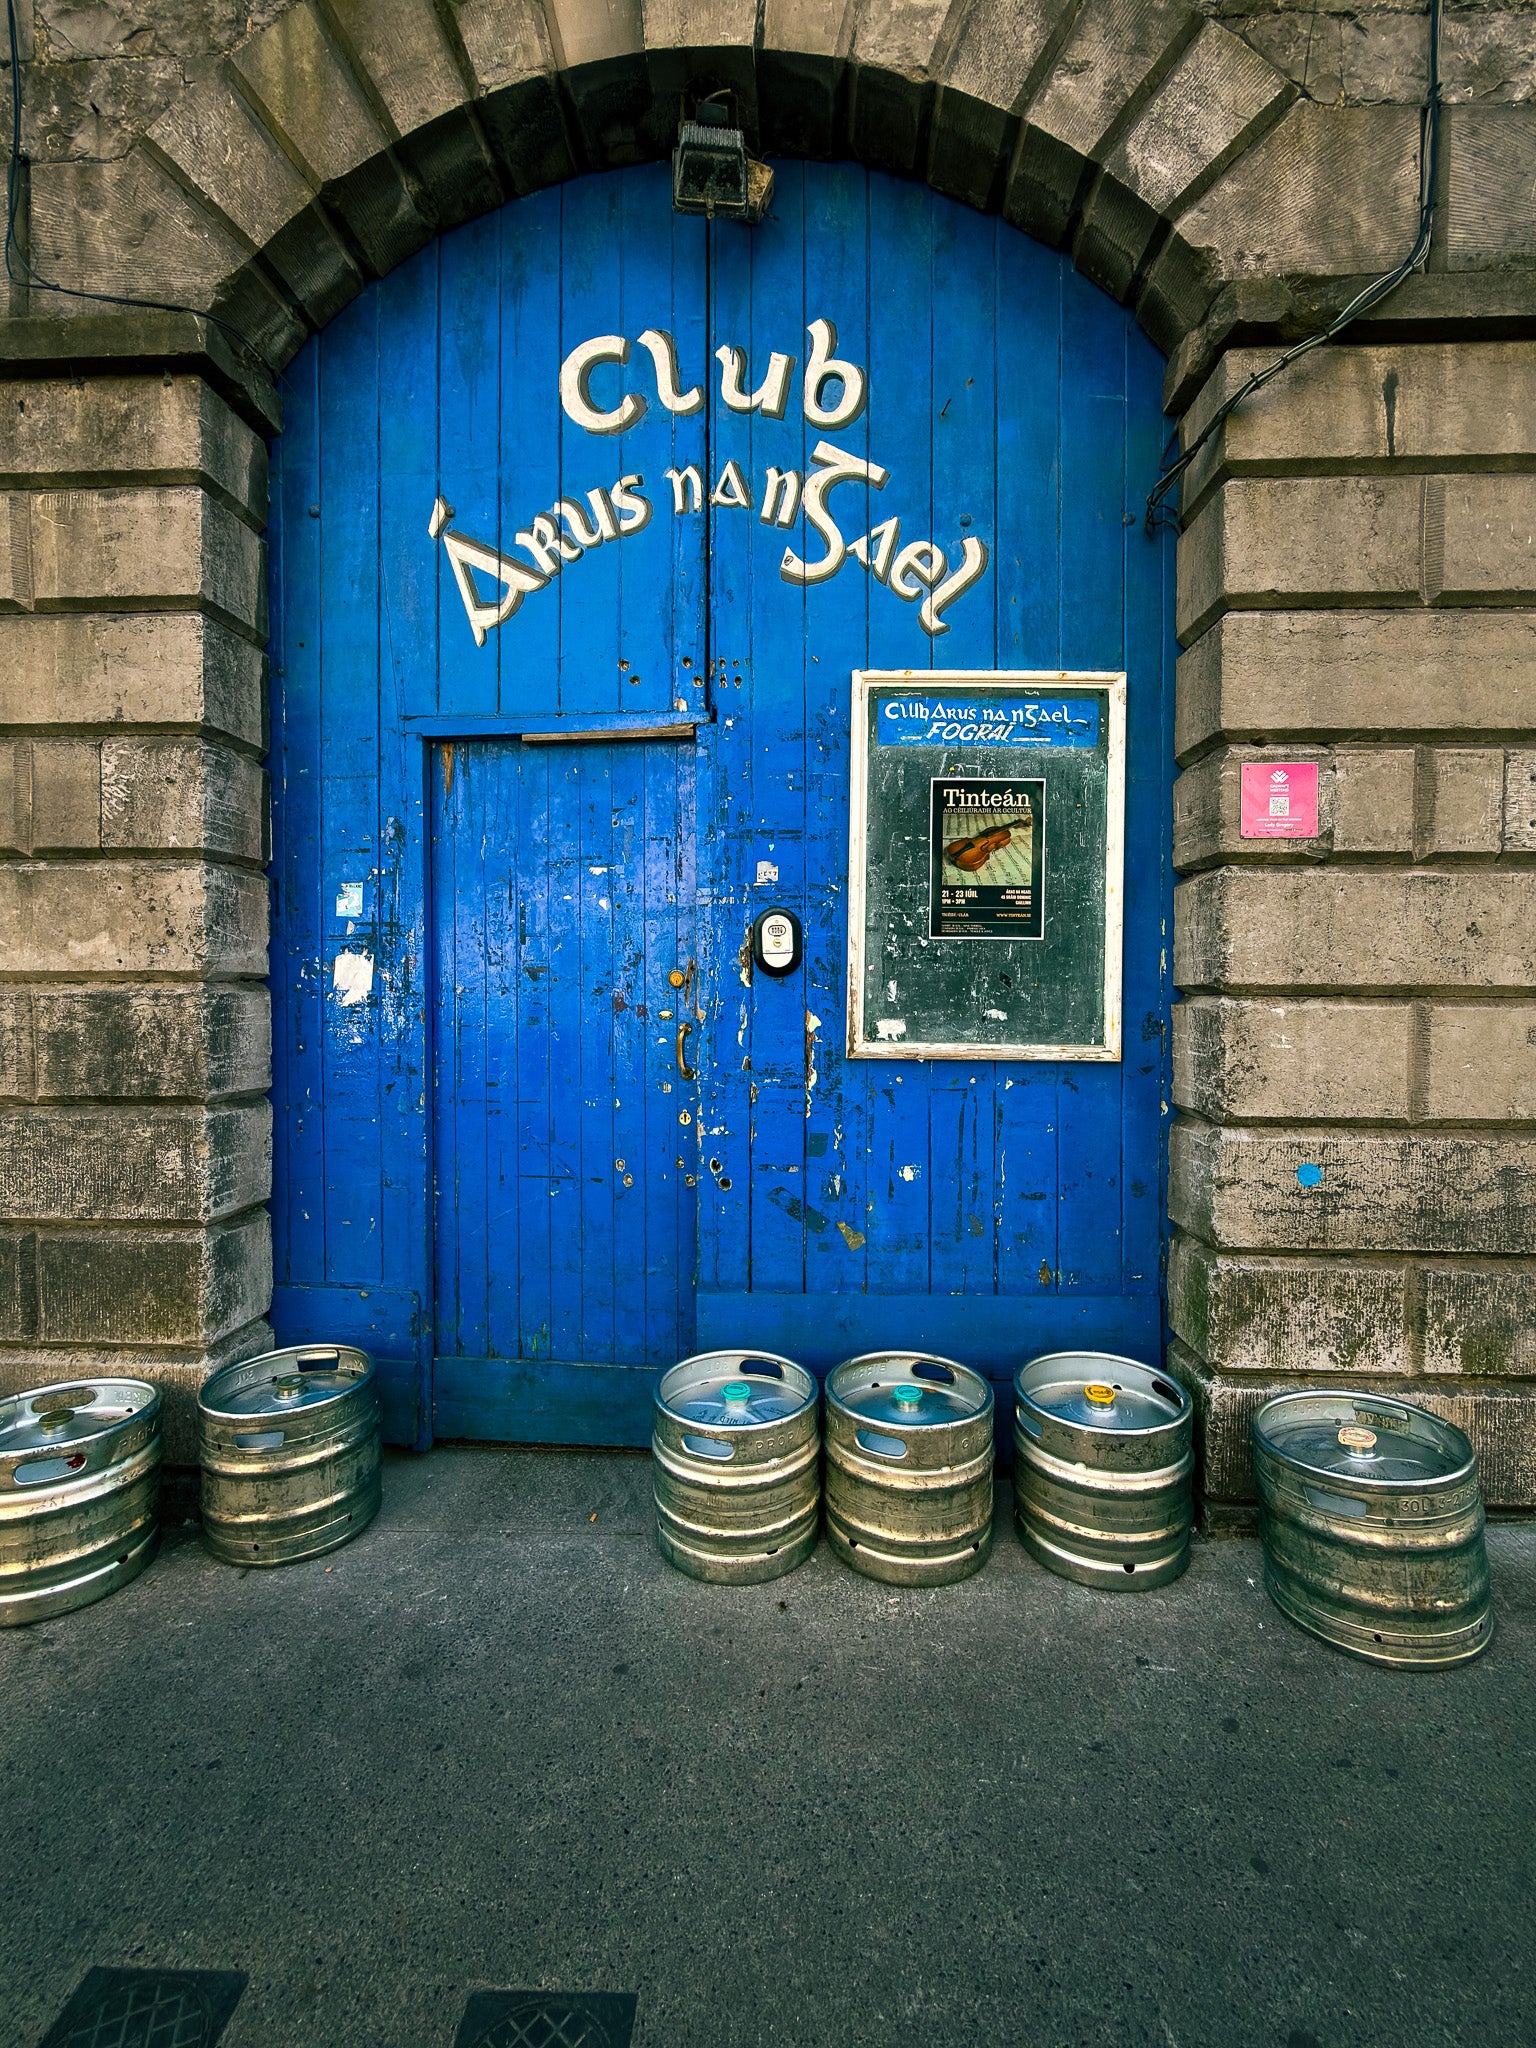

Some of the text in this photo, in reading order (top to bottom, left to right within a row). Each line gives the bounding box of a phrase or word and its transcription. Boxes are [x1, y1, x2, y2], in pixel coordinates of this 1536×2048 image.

[559, 318, 867, 436] Club
[884, 702, 930, 722] Club
[943, 788, 1032, 807] Tinteán
[941, 890, 949, 898] 21
[955, 890, 964, 898] 23
[1401, 1497, 1429, 1512] 30L
